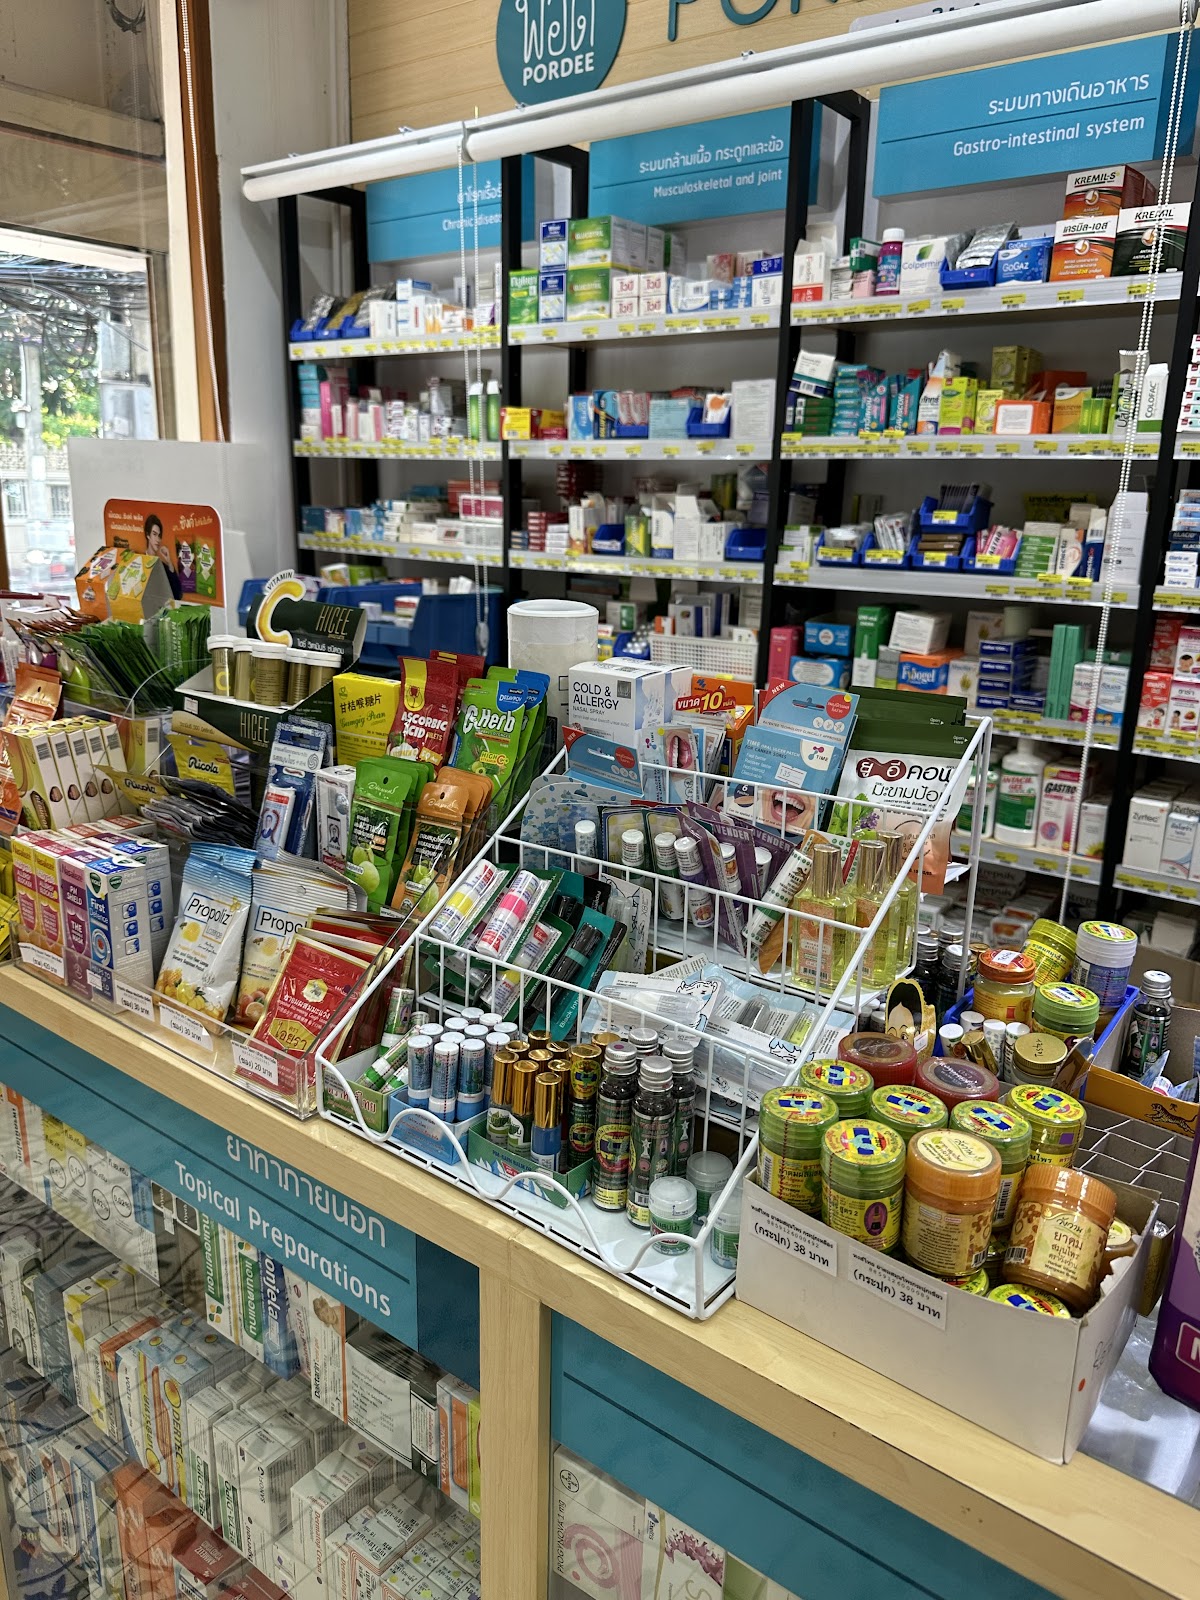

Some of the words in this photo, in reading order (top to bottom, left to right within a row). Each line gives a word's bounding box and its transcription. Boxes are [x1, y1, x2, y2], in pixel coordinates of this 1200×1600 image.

[522, 52, 595, 86] PORDEE
[987, 73, 1150, 115] ระบบทางเดินอาหาร
[953, 123, 1081, 156] Gastro-intestinal
[1085, 116, 1146, 139] system
[639, 144, 712, 174] ระบบกล้ามเนื้อ
[714, 133, 784, 170] กระดูกและข้อ
[653, 175, 733, 198] Musculoskeletal
[735, 172, 755, 186] and
[756, 168, 782, 186] joint
[1074, 170, 1116, 186] KREMIL-S
[1145, 382, 1157, 418] COLOFAC
[267, 572, 293, 591] VITAMIN
[315, 605, 354, 636] HICEE
[901, 666, 936, 684] Fybogel
[573, 681, 602, 695] COLD
[604, 686, 612, 698] &
[771, 682, 786, 695] NEW
[339, 693, 383, 714] 甘桔喉糖片
[572, 705, 589, 713] NASAL
[573, 693, 620, 711] ALLERGY
[677, 697, 701, 710] ขนาด
[701, 692, 724, 711] 10
[240, 711, 270, 744] HICEE
[401, 711, 448, 732] ASCORBIC
[403, 724, 426, 739] ACID
[481, 708, 517, 734] Herb
[481, 751, 498, 761] HIGH
[746, 739, 761, 749] TIME
[786, 749, 800, 757] PATCH
[773, 751, 787, 760] SORES
[816, 754, 829, 762] TIME
[188, 757, 220, 774] Ricola
[1132, 812, 1158, 824] Zyrtec
[66, 893, 83, 906] SHIELD
[90, 900, 106, 913] First
[89, 910, 109, 924] Defence
[187, 898, 231, 926] Propoliz
[71, 922, 82, 933] THE
[140, 1007, 150, 1016] บาท
[559, 1011, 573, 1029] Black
[184, 1027, 191, 1035] 30
[191, 1031, 202, 1042] บาท
[238, 1054, 254, 1070] (ซอง)
[254, 1062, 262, 1072] 20
[262, 1067, 273, 1079] บาท
[226, 1132, 386, 1248] ยาทาภายนอก
[174, 1159, 240, 1221] Topical
[248, 1205, 391, 1318] Preparations
[754, 1222, 791, 1250] (กระปุก)
[793, 1241, 806, 1256] 38
[808, 1250, 830, 1268] บาท
[1053, 1230, 1083, 1251] ยาดม
[1051, 1243, 1080, 1260] สมุนไพร
[853, 1268, 897, 1299] (กระปุก)
[899, 1290, 914, 1306] 38
[916, 1301, 941, 1320] บาท
[313, 1361, 321, 1399] Daktarin
[171, 1408, 183, 1463] DERTEC
[441, 1425, 449, 1484] KANOLONE
[224, 1480, 237, 1546] BETA-DIPO
[558, 1499, 567, 1512] mg
[313, 1510, 322, 1546] Dermatop
[557, 1521, 566, 1574] PROGYNOVA
[315, 1546, 323, 1574] Cream
